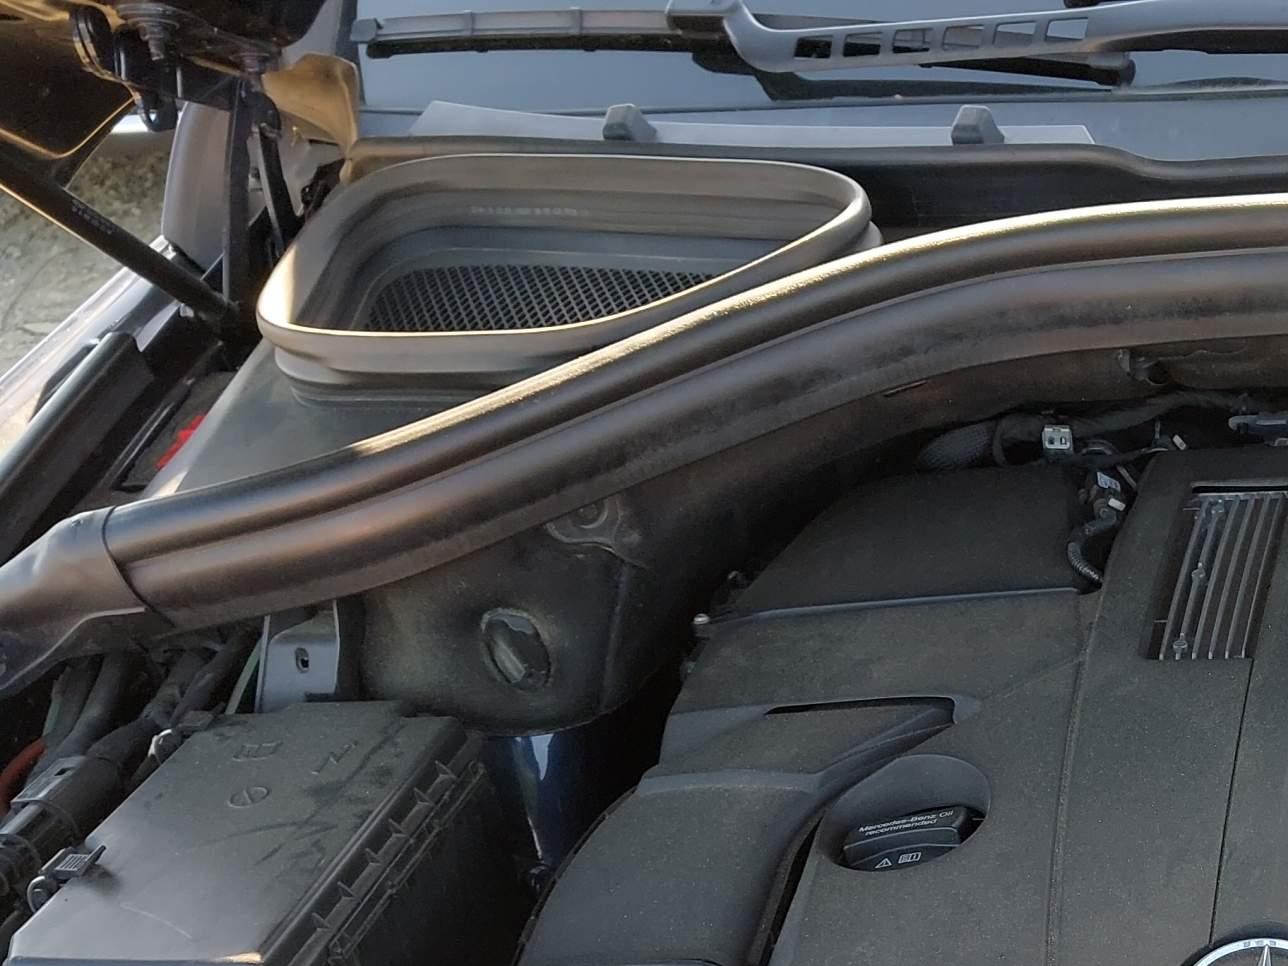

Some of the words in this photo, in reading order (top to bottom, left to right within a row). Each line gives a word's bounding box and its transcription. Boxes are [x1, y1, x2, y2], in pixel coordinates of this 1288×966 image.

[858, 813, 936, 833] Mercedes-Benz
[938, 810, 954, 819] Oil
[864, 818, 938, 836] recommended
